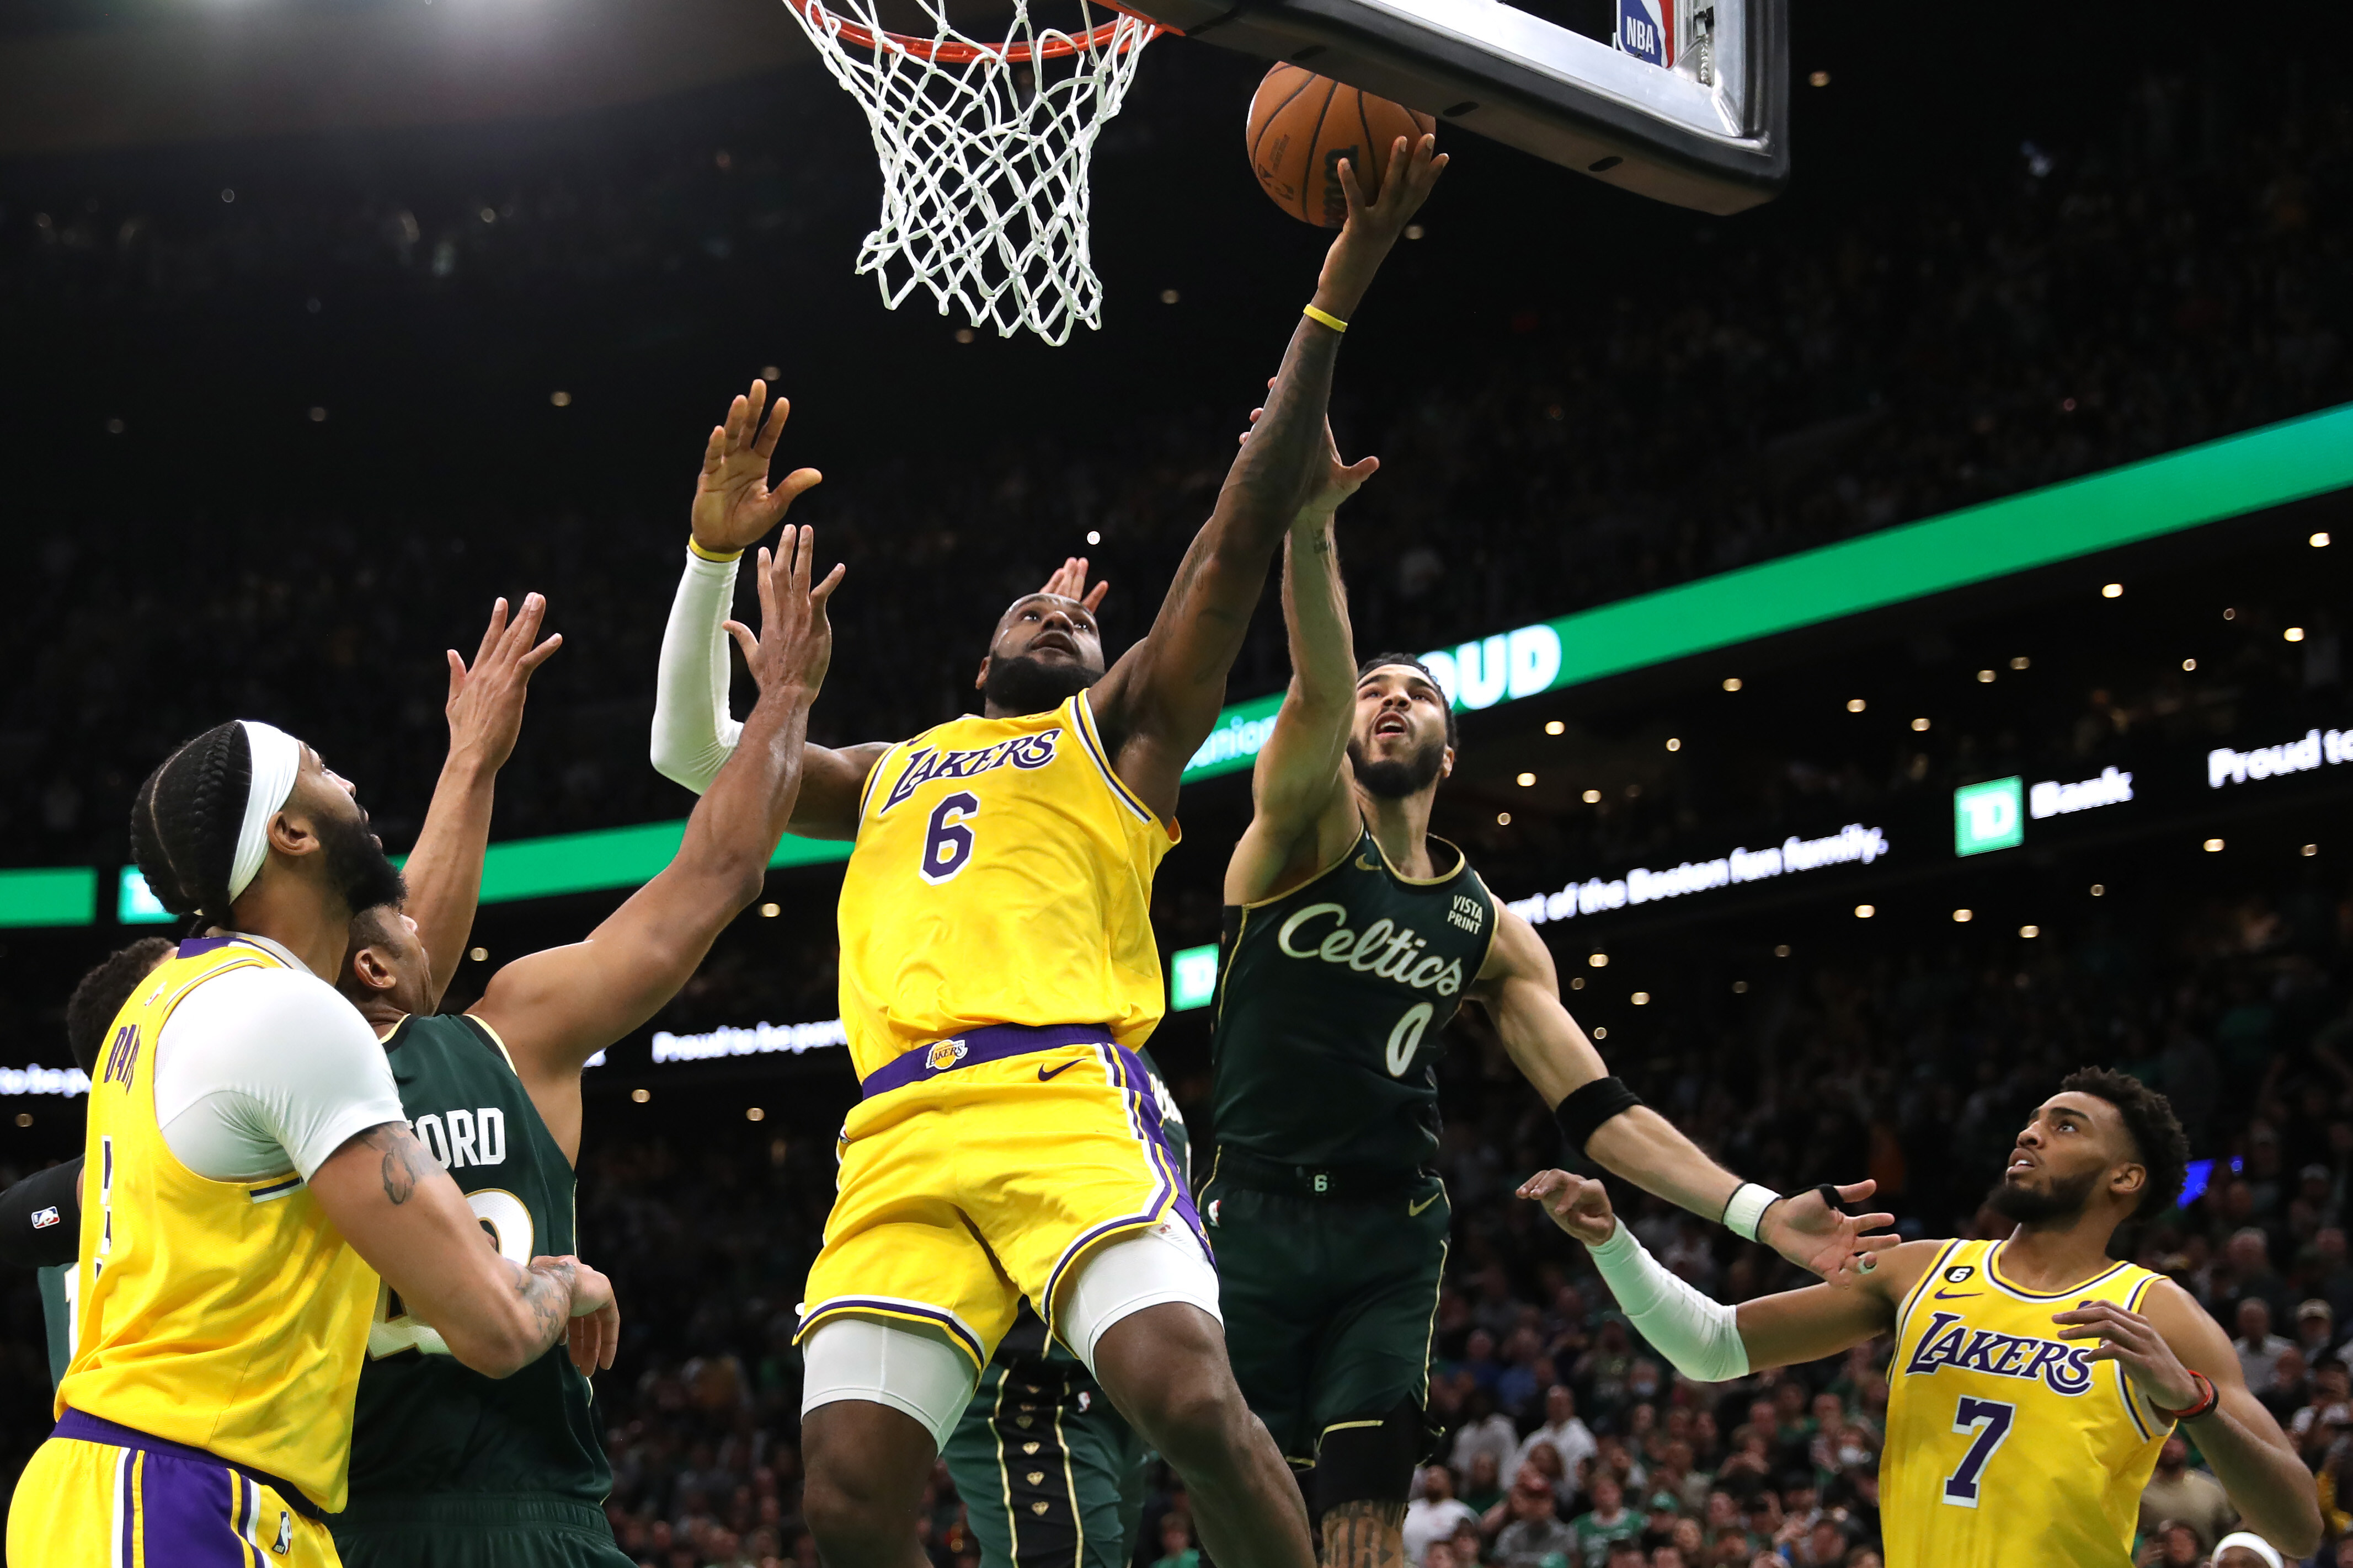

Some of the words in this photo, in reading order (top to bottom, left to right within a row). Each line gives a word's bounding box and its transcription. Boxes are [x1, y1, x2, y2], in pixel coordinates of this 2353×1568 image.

[1626, 15, 1655, 55] NBA
[878, 728, 1063, 817] LAKERS
[2208, 729, 2322, 789] Proud
[1959, 792, 2018, 841] TD
[2030, 766, 2133, 819] Bank
[919, 790, 980, 886] 6
[1447, 909, 1481, 934] PRINT
[1453, 895, 1483, 923] VISTA
[1278, 903, 1462, 996] Celtics
[928, 1045, 967, 1066] LAKERS
[1386, 1002, 1433, 1078] 0
[406, 1107, 506, 1170] ORD
[1314, 1174, 1328, 1192] 6
[1949, 1267, 1971, 1282] 6
[1905, 1311, 2095, 1396] LAKERS
[1941, 1394, 2016, 1508] 7
